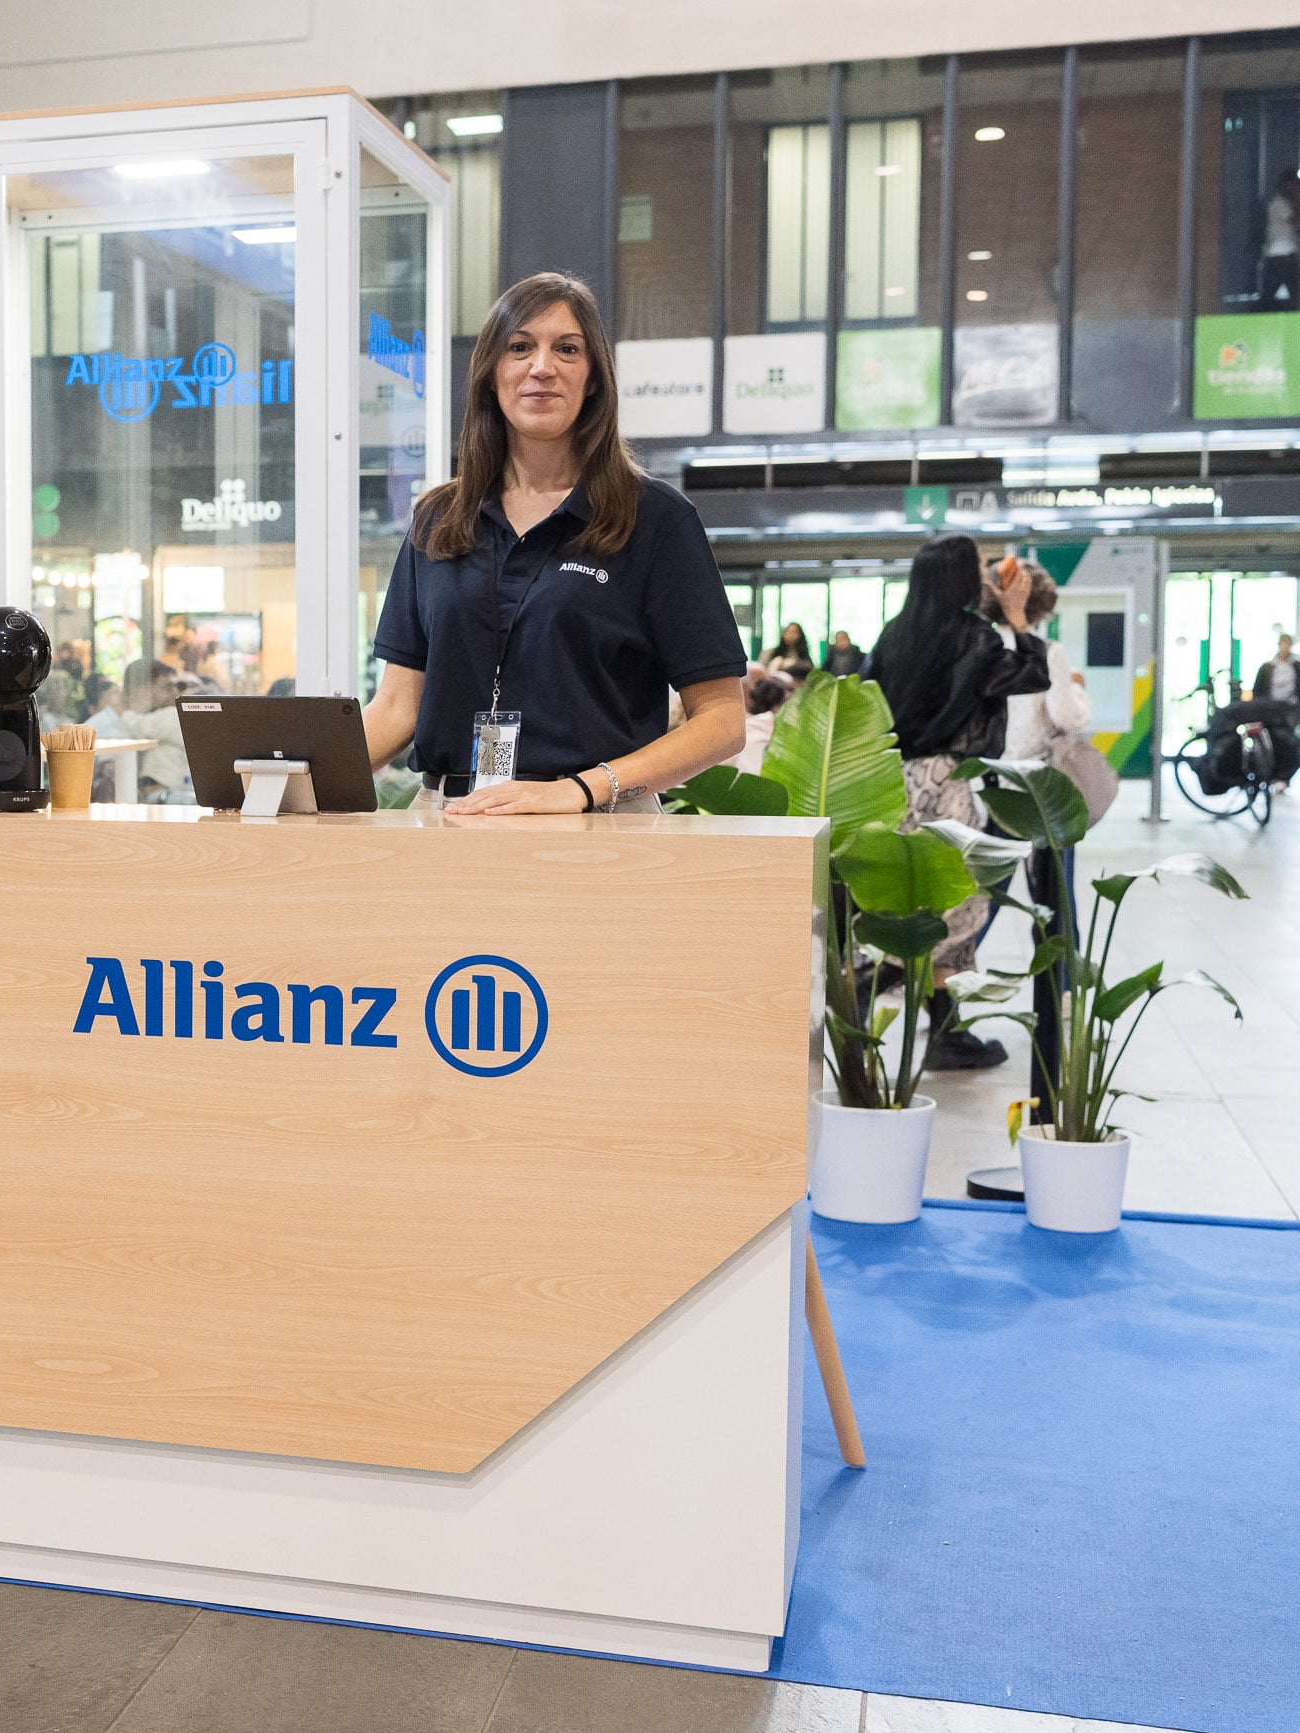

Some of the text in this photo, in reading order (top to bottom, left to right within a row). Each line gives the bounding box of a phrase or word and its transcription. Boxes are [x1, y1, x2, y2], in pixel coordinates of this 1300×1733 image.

[65, 353, 185, 385] Allianz
[180, 497, 283, 528] Deliquo
[559, 562, 597, 576] Allianz
[73, 957, 398, 1048] Allianz
